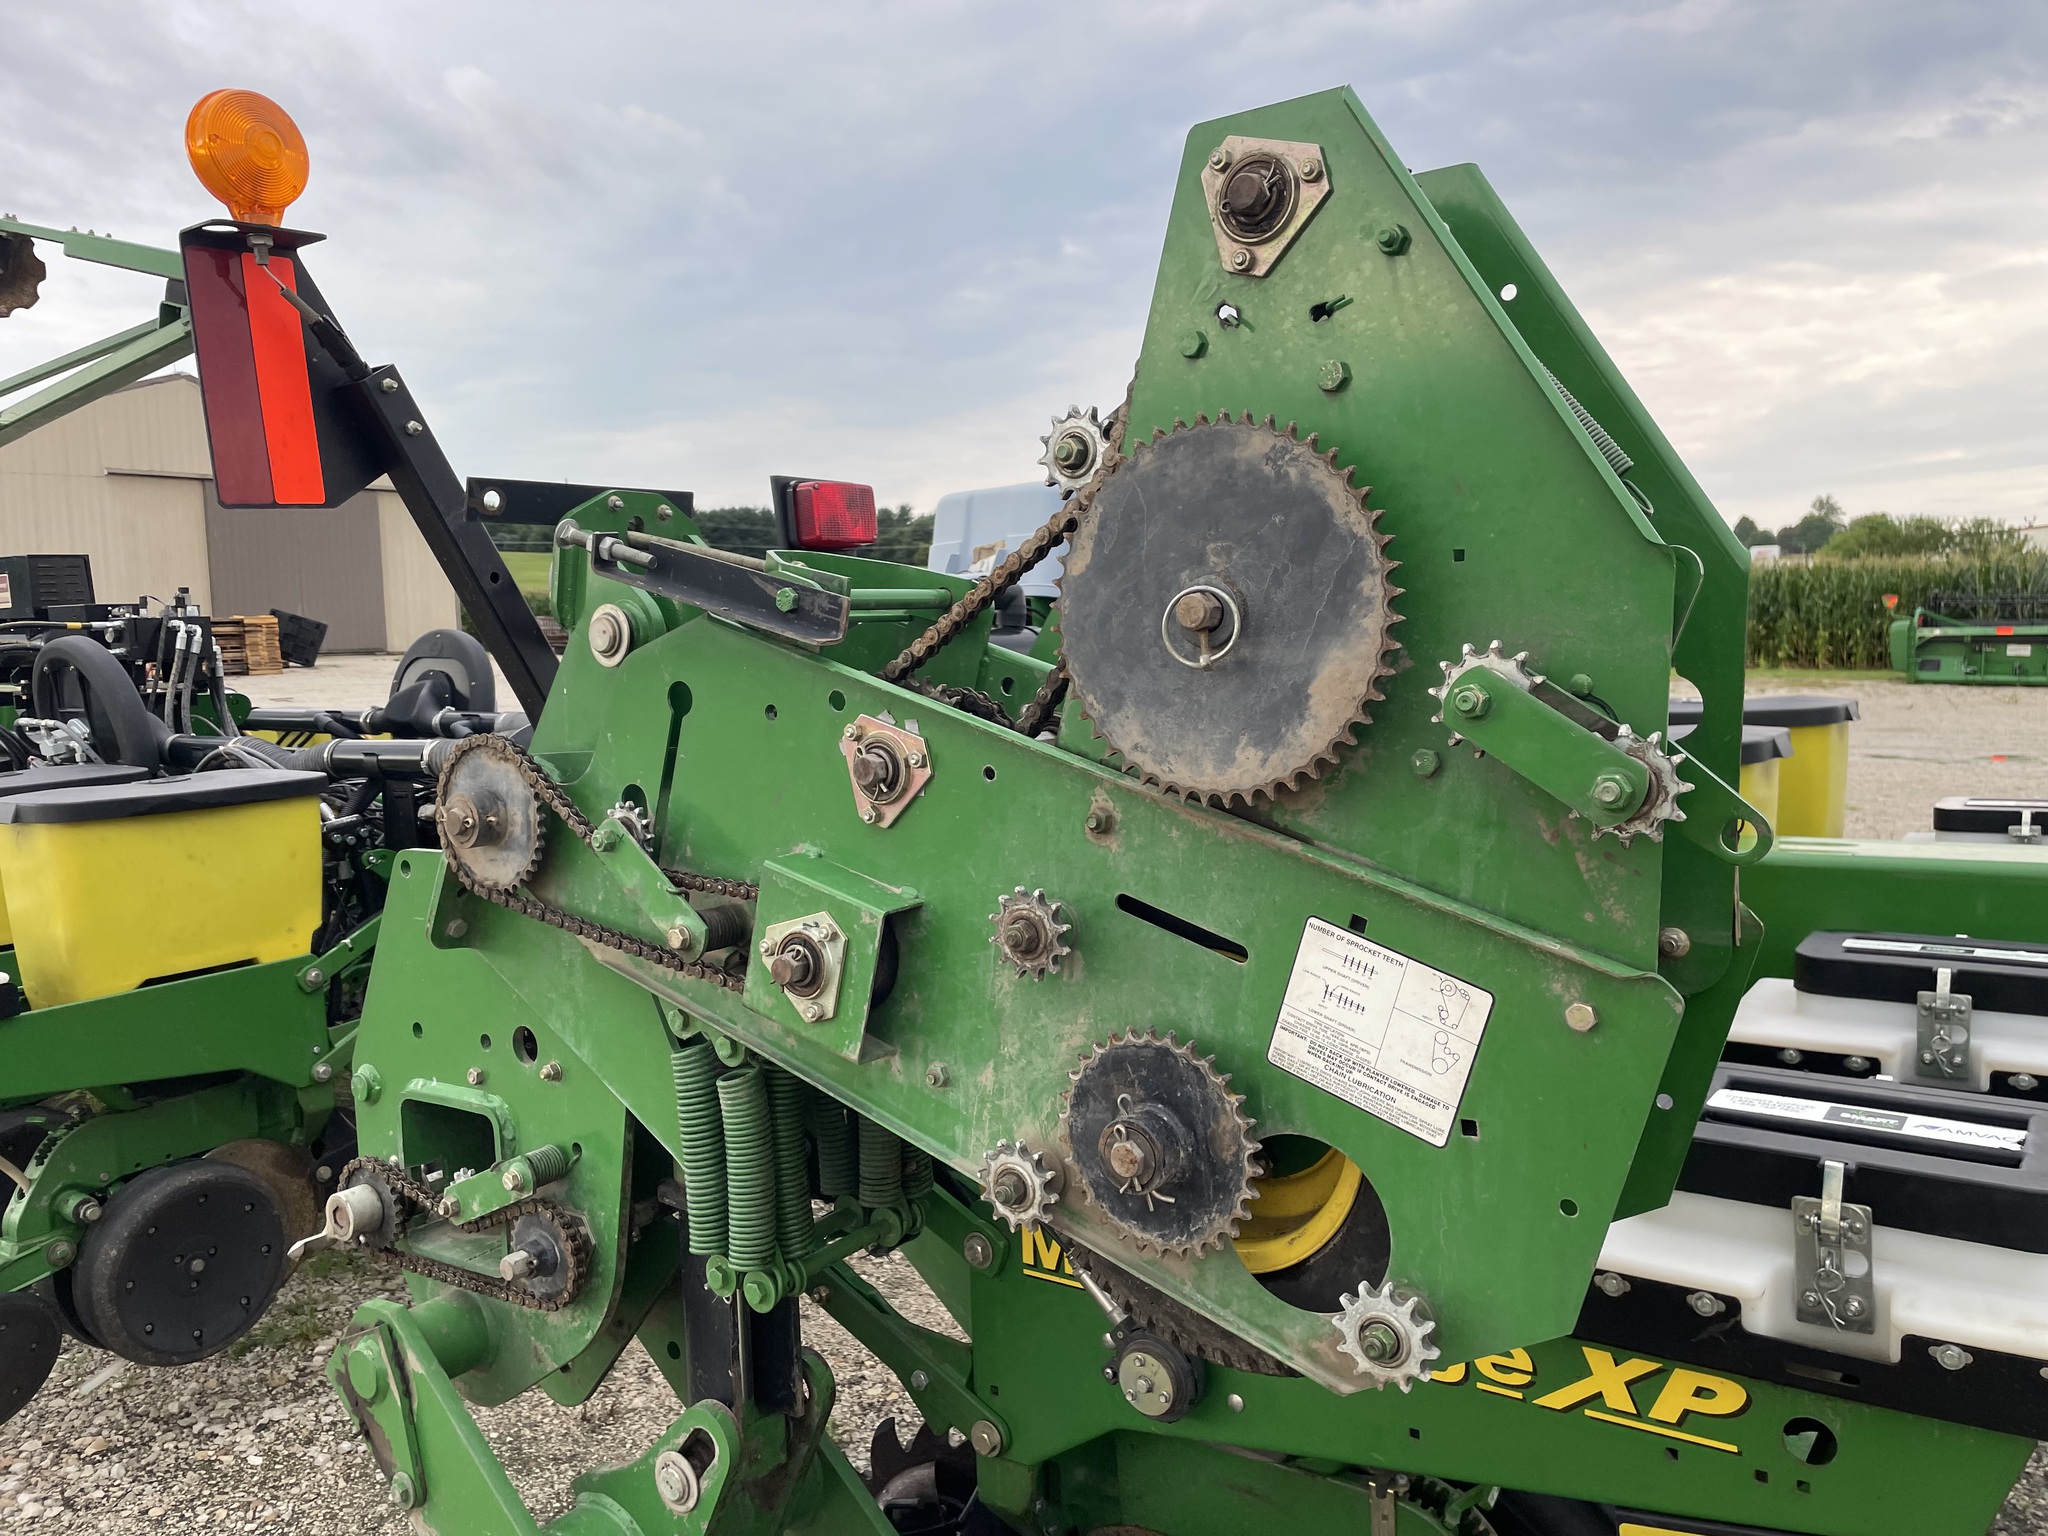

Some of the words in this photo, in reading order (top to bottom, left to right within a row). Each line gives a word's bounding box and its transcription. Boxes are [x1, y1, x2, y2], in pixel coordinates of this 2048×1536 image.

[1308, 921, 1335, 938] NUMBER
[1335, 933, 1345, 942] OF
[1345, 938, 1381, 958] SPROCKET
[1381, 953, 1404, 968] TEETH
[1279, 1024, 1307, 1041] IMPORTANT:
[1317, 1043, 1328, 1052] NOT
[1328, 1048, 1342, 1059] BACK
[1351, 1060, 1365, 1070] WITH
[1365, 1066, 1389, 1081] PLANTER
[1418, 1092, 1441, 1106] DAMAGE
[1441, 1103, 1449, 1111] TO
[1306, 1049, 1321, 1060] WHEN
[1321, 1056, 1344, 1071] BACKING
[1308, 1044, 1326, 1056] DRIVES
[1326, 1053, 1337, 1062] MAY
[1337, 1059, 1356, 1071] OCCUR
[1362, 1071, 1386, 1086] CONTACT
[1387, 1083, 1403, 1094] DRIVE
[1410, 1094, 1436, 1110] ENGAGED
[1399, 1058, 1432, 1077] TRANSMISSION
[1323, 1063, 1346, 1079] CHAIN
[1347, 1075, 1396, 1104] LUBRICATION
[1938, 1127, 2017, 1144] AMVAC
[1532, 1346, 1750, 1426] XP
